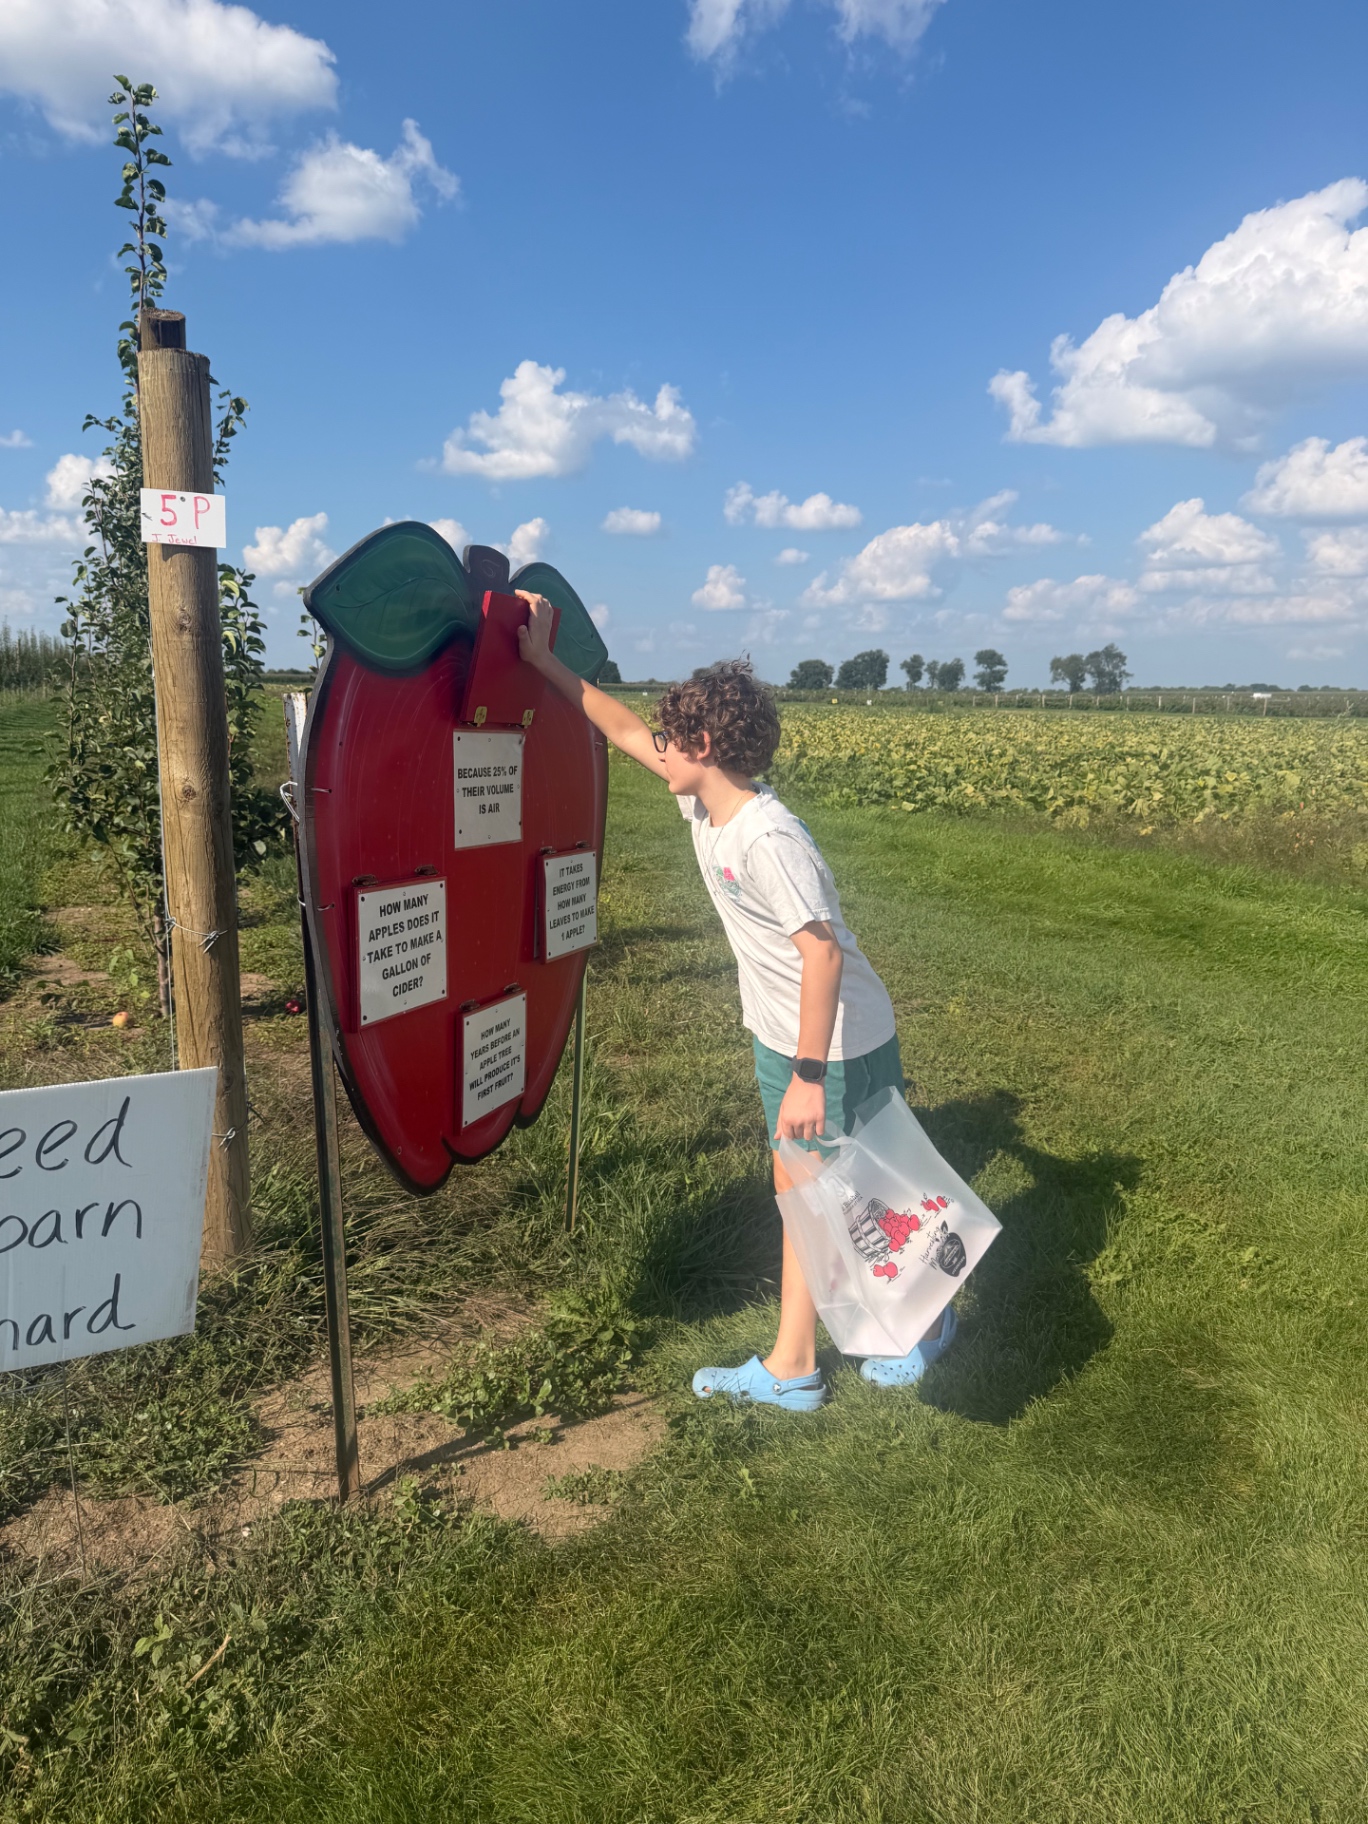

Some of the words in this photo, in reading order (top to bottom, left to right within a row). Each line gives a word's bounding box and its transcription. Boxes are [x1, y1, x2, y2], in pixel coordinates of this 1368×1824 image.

[160, 494, 178, 526] 5
[193, 496, 211, 530] P
[167, 533, 197, 545] Jewel
[457, 767, 492, 779] BECAUSE
[493, 766, 507, 777] 25%
[508, 765, 518, 776] OF
[462, 786, 485, 797] THEIR
[486, 783, 514, 796] VOLUME
[479, 804, 486, 815] IS
[488, 803, 500, 814] AIR
[559, 867, 565, 878] IT
[566, 863, 583, 876] TAKES
[552, 881, 575, 896] ENERGY
[575, 876, 590, 889] FROM
[379, 900, 401, 918] HOW
[403, 893, 429, 911] MANY
[557, 898, 571, 911] HOW
[571, 893, 587, 906] MANY
[368, 921, 405, 943] APPLES
[407, 914, 430, 931] DOES
[431, 910, 440, 923] IT
[549, 914, 571, 930] LEAVES
[572, 911, 579, 922] TO
[580, 905, 595, 918] MAKE
[561, 932, 565, 941] 1
[565, 924, 585, 940] APPLE?
[367, 945, 393, 964] TAKE
[395, 941, 408, 955] TO
[410, 932, 434, 951] MAKE
[436, 930, 442, 941] A
[382, 957, 418, 980] GALLON
[420, 953, 432, 967] OF
[392, 976, 424, 997] CIDER?
[480, 1026, 495, 1041] HOW
[495, 1018, 511, 1033] MANY
[470, 1044, 490, 1061] YEARS
[490, 1031, 512, 1050] BEFORE
[512, 1027, 520, 1039] AN
[479, 1053, 498, 1071] APPLE
[498, 1045, 512, 1060] TREE
[469, 1077, 483, 1091] WILL
[484, 1060, 510, 1083] PRODUCE
[510, 1054, 521, 1068] IT'S
[477, 1084, 494, 1101] FIRST
[494, 1072, 514, 1090] FRUIT?
